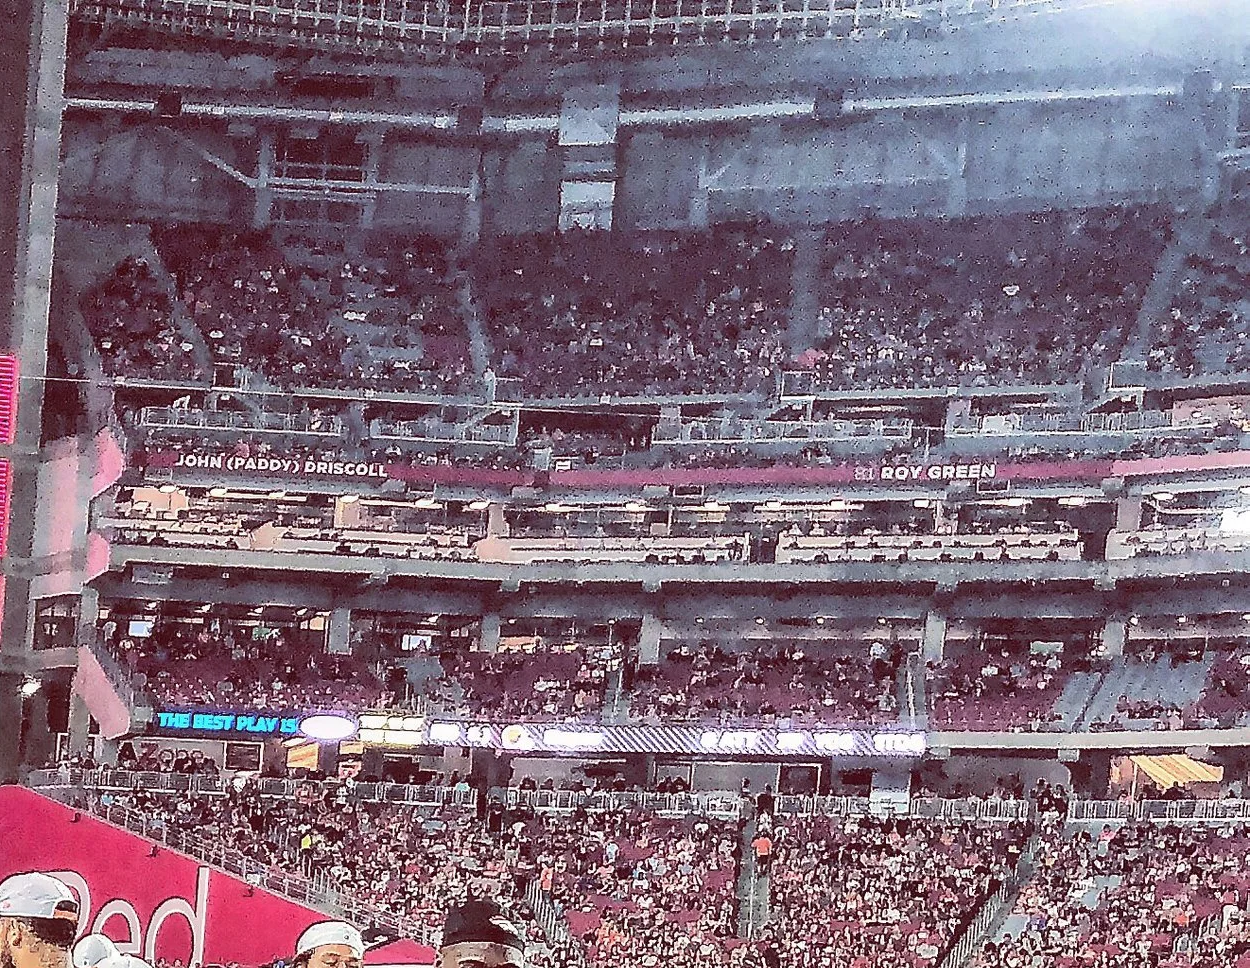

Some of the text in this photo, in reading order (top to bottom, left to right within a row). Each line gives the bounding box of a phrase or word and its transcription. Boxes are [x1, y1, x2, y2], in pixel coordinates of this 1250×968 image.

[175, 453, 388, 478] JOHN (PADDY) DRISCOLL
[880, 465, 923, 481] ROY
[927, 463, 996, 479] GREEN
[158, 711, 191, 729] THE
[192, 712, 235, 731] BEST
[236, 715, 276, 734] PLAY
